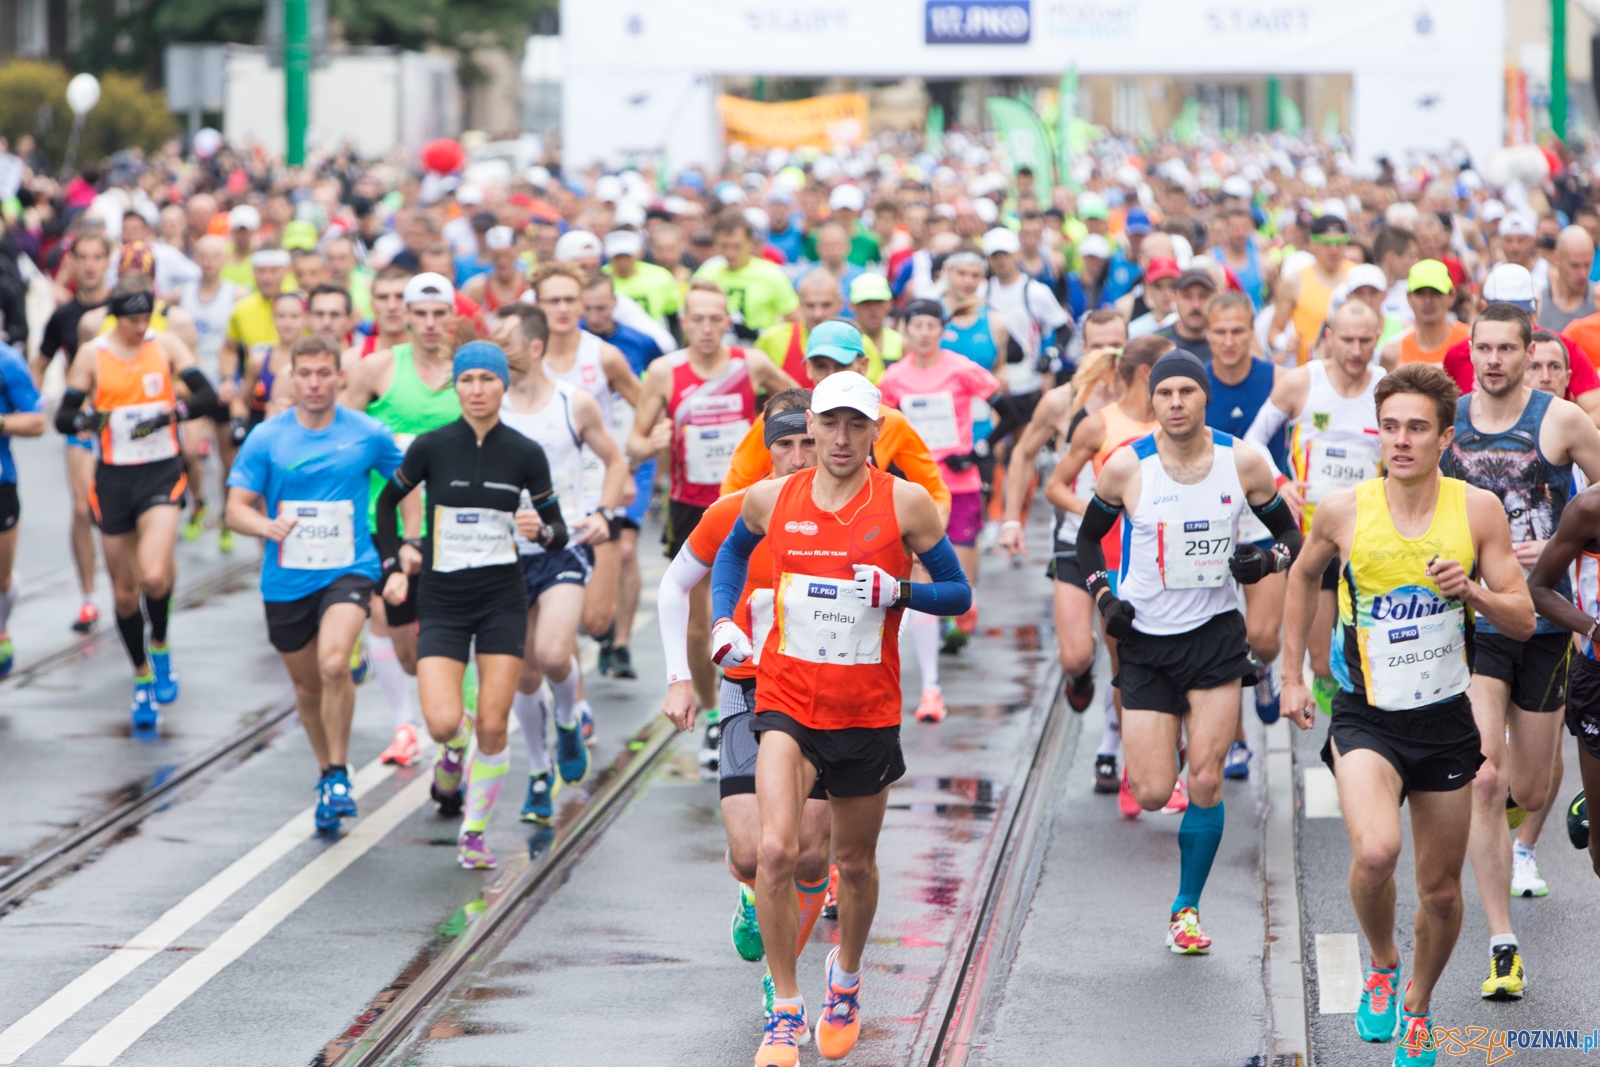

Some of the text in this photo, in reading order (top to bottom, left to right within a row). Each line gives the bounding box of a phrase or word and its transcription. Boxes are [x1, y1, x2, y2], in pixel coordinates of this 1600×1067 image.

[1204, 6, 1309, 33] START
[1321, 463, 1365, 481] 4394
[296, 524, 340, 540] 2984
[1186, 522, 1208, 531] 17.PKO
[1185, 537, 1231, 556] 2977
[1194, 559, 1224, 567] Bartosz
[810, 586, 837, 596] 17.PKO
[1370, 594, 1452, 620] Volvic
[813, 610, 856, 624] Fehlau
[829, 632, 837, 640] 3
[1390, 628, 1417, 640] 17.PKO
[1387, 643, 1453, 668] ZABLOCKI
[1420, 670, 1430, 680] 15
